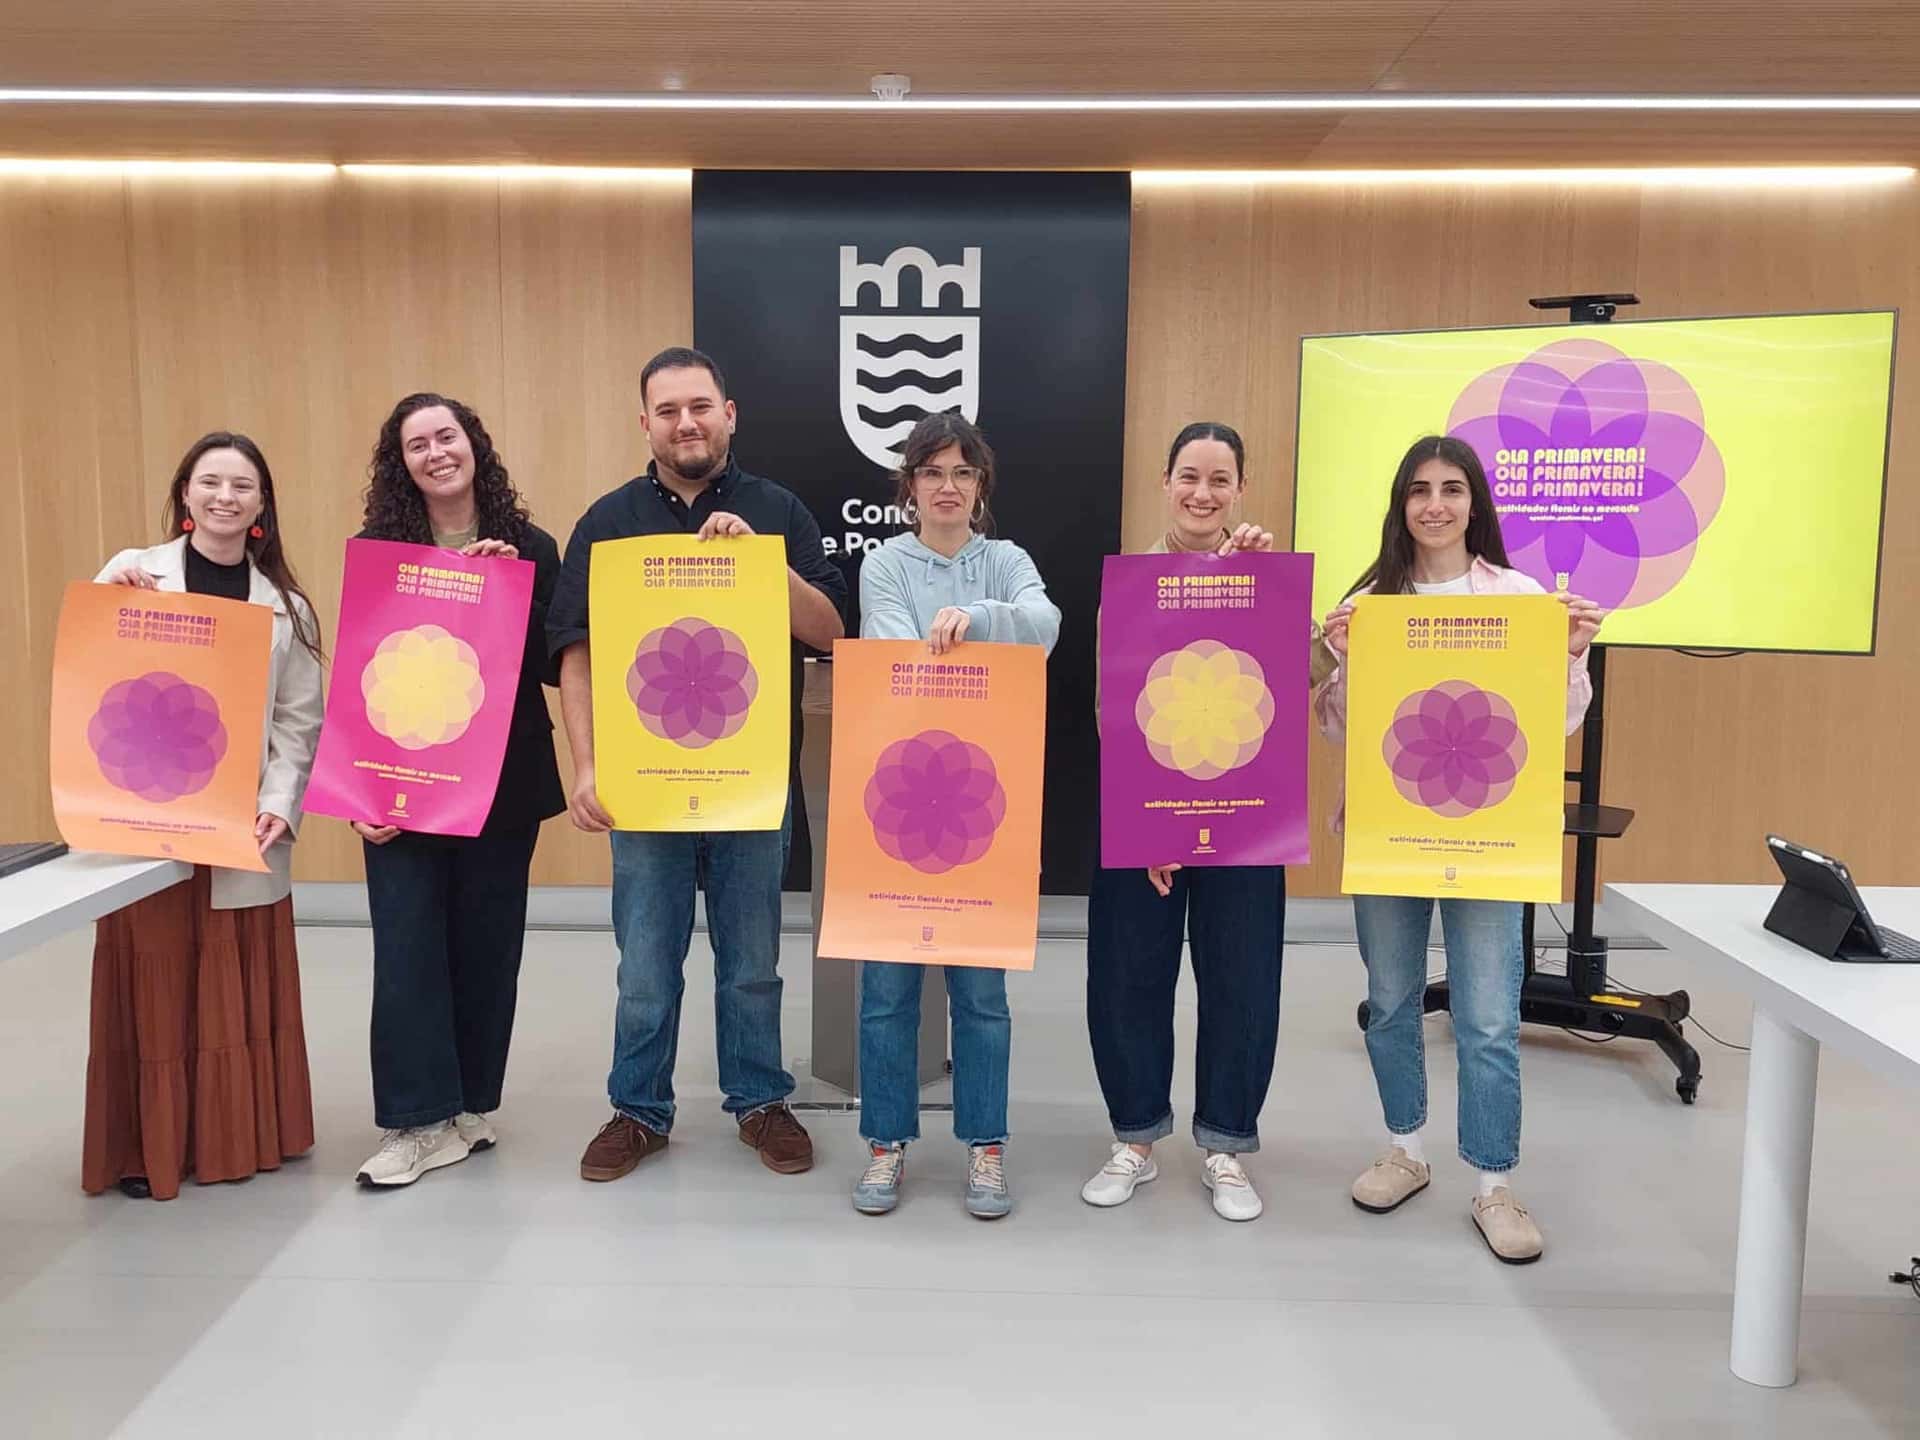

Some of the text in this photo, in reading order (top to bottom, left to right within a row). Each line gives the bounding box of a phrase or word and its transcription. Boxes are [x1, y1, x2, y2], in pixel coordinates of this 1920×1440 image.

[1495, 447, 1646, 464] OLA PRIMAVERA!
[1494, 464, 1645, 481] OLA PRIMAVERA!
[1494, 481, 1644, 497] OLA PRIMAVERA!
[822, 536, 838, 556] e
[643, 556, 736, 567] OLA PRIMAVERA!
[398, 563, 485, 585] OLA PRIMAVERA!
[644, 567, 736, 578] OLA PRIMAVERA!
[397, 573, 484, 595] OLA PRIMAVERA!
[1157, 575, 1256, 588] OLA PRIMAVERA!
[395, 583, 482, 605] OLA PRIMAVERA!
[1157, 586, 1256, 598] OLA PRIMAVERA!
[1157, 598, 1256, 610] OLA PRIMAVERA!
[119, 607, 217, 627] OLA PRIMAVERA!
[1407, 617, 1509, 628] OLA PRIMAVERA!
[118, 618, 217, 638] OLA PRIMAVERA!
[1407, 628, 1508, 639] OLA PRIMAVERA!
[1407, 639, 1508, 650] OLA PRIMAVERA!
[891, 663, 989, 677] OLA PRIMAVERA!
[891, 674, 989, 689] OLA PRIMAVERA!
[890, 686, 988, 701] OLA PRIMAVERA!
